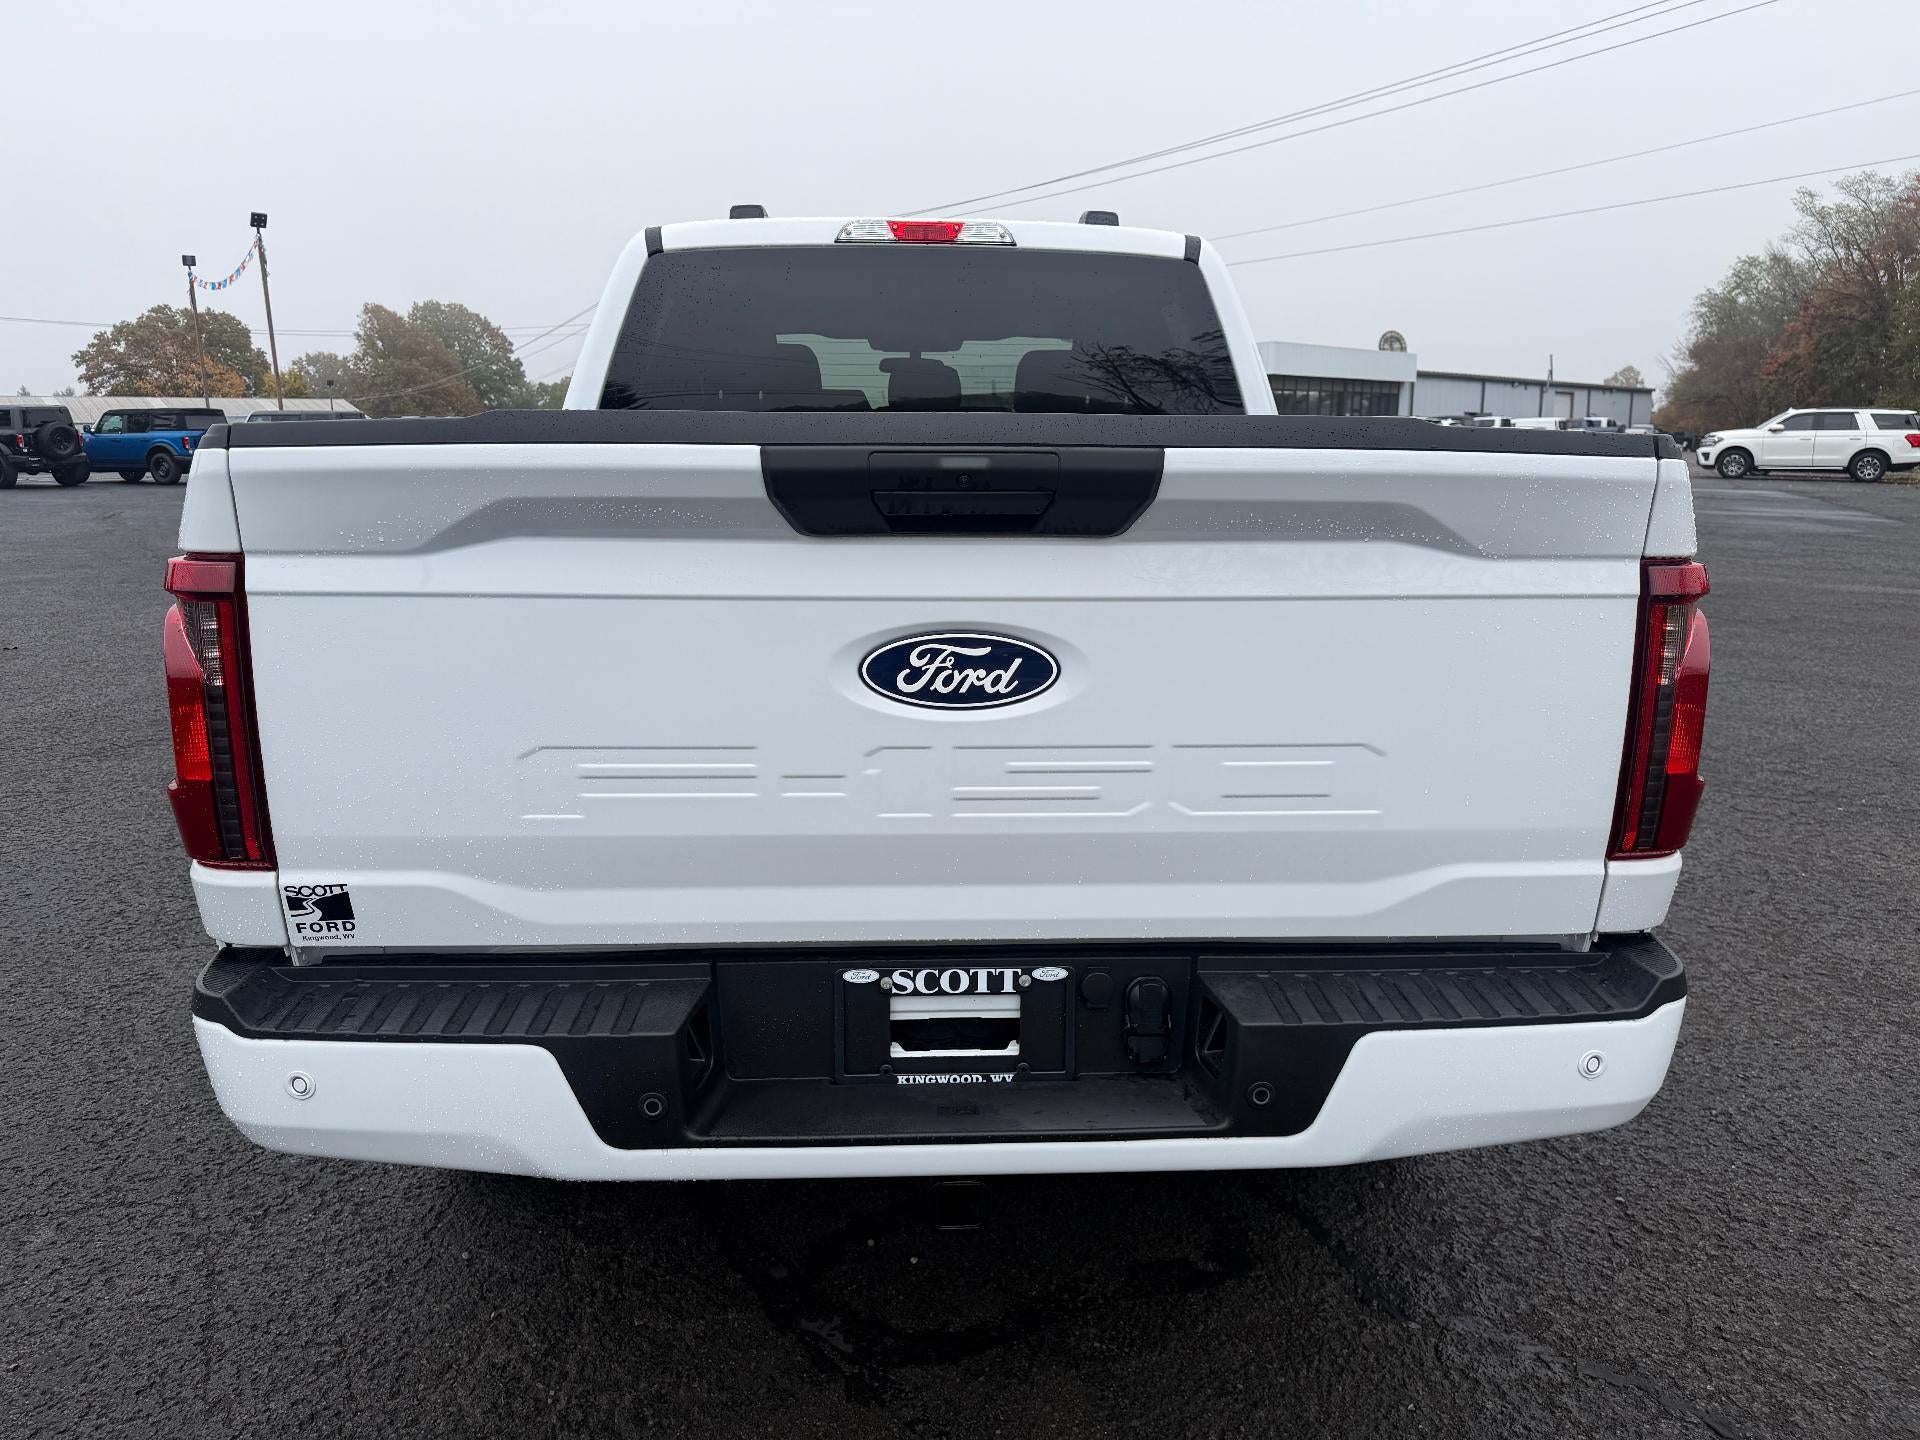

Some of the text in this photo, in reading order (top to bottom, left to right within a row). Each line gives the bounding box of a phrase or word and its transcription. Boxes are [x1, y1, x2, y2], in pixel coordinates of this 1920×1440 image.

[896, 643, 1023, 694] Ford
[517, 742, 1388, 819] F-150
[283, 883, 348, 897] SCOTT
[295, 920, 356, 934] FORD
[891, 968, 1022, 995] SCOTT
[989, 1074, 1015, 1083] WV
